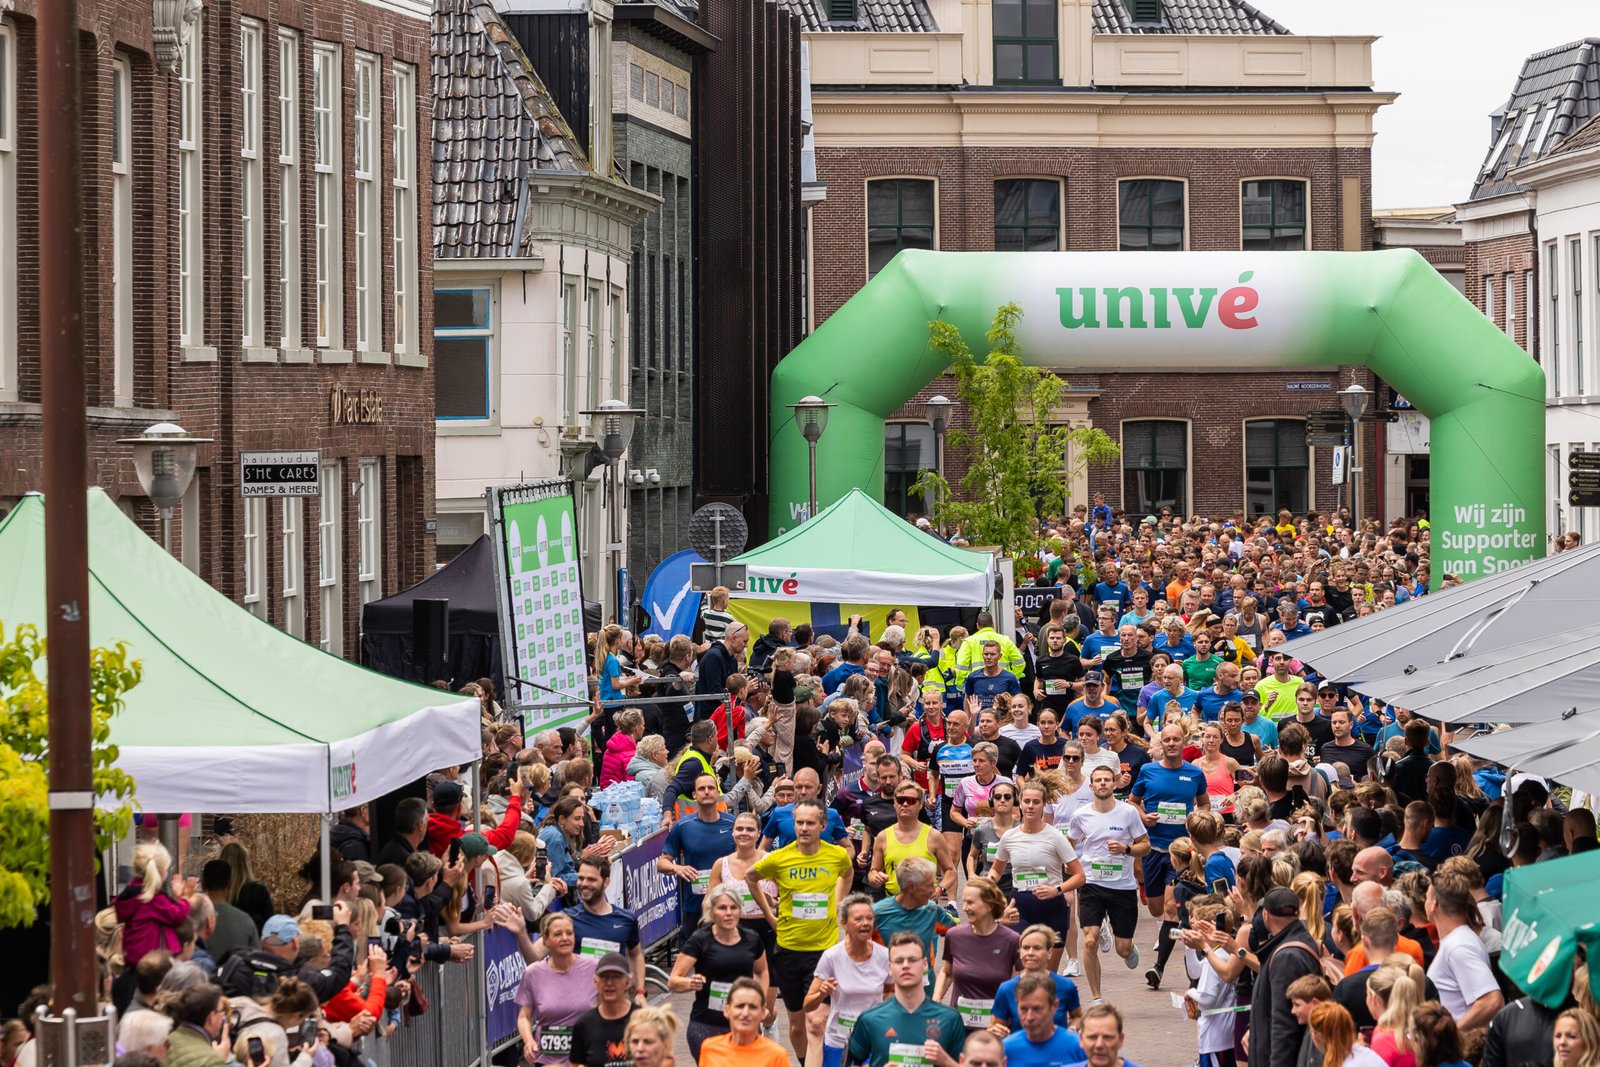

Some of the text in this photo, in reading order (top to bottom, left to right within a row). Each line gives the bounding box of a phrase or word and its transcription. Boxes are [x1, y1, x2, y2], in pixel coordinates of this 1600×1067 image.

[1056, 270, 1259, 330] univé
[242, 453, 318, 463] hairstudio
[245, 466, 316, 480] S'HE CARES
[243, 486, 275, 494] DAMES
[289, 485, 318, 493] HEREN
[1454, 503, 1526, 529] Wij zijn
[1441, 529, 1537, 554] Supporter
[1443, 558, 1477, 574] van
[748, 572, 798, 595] nivé
[789, 868, 817, 880] RUN
